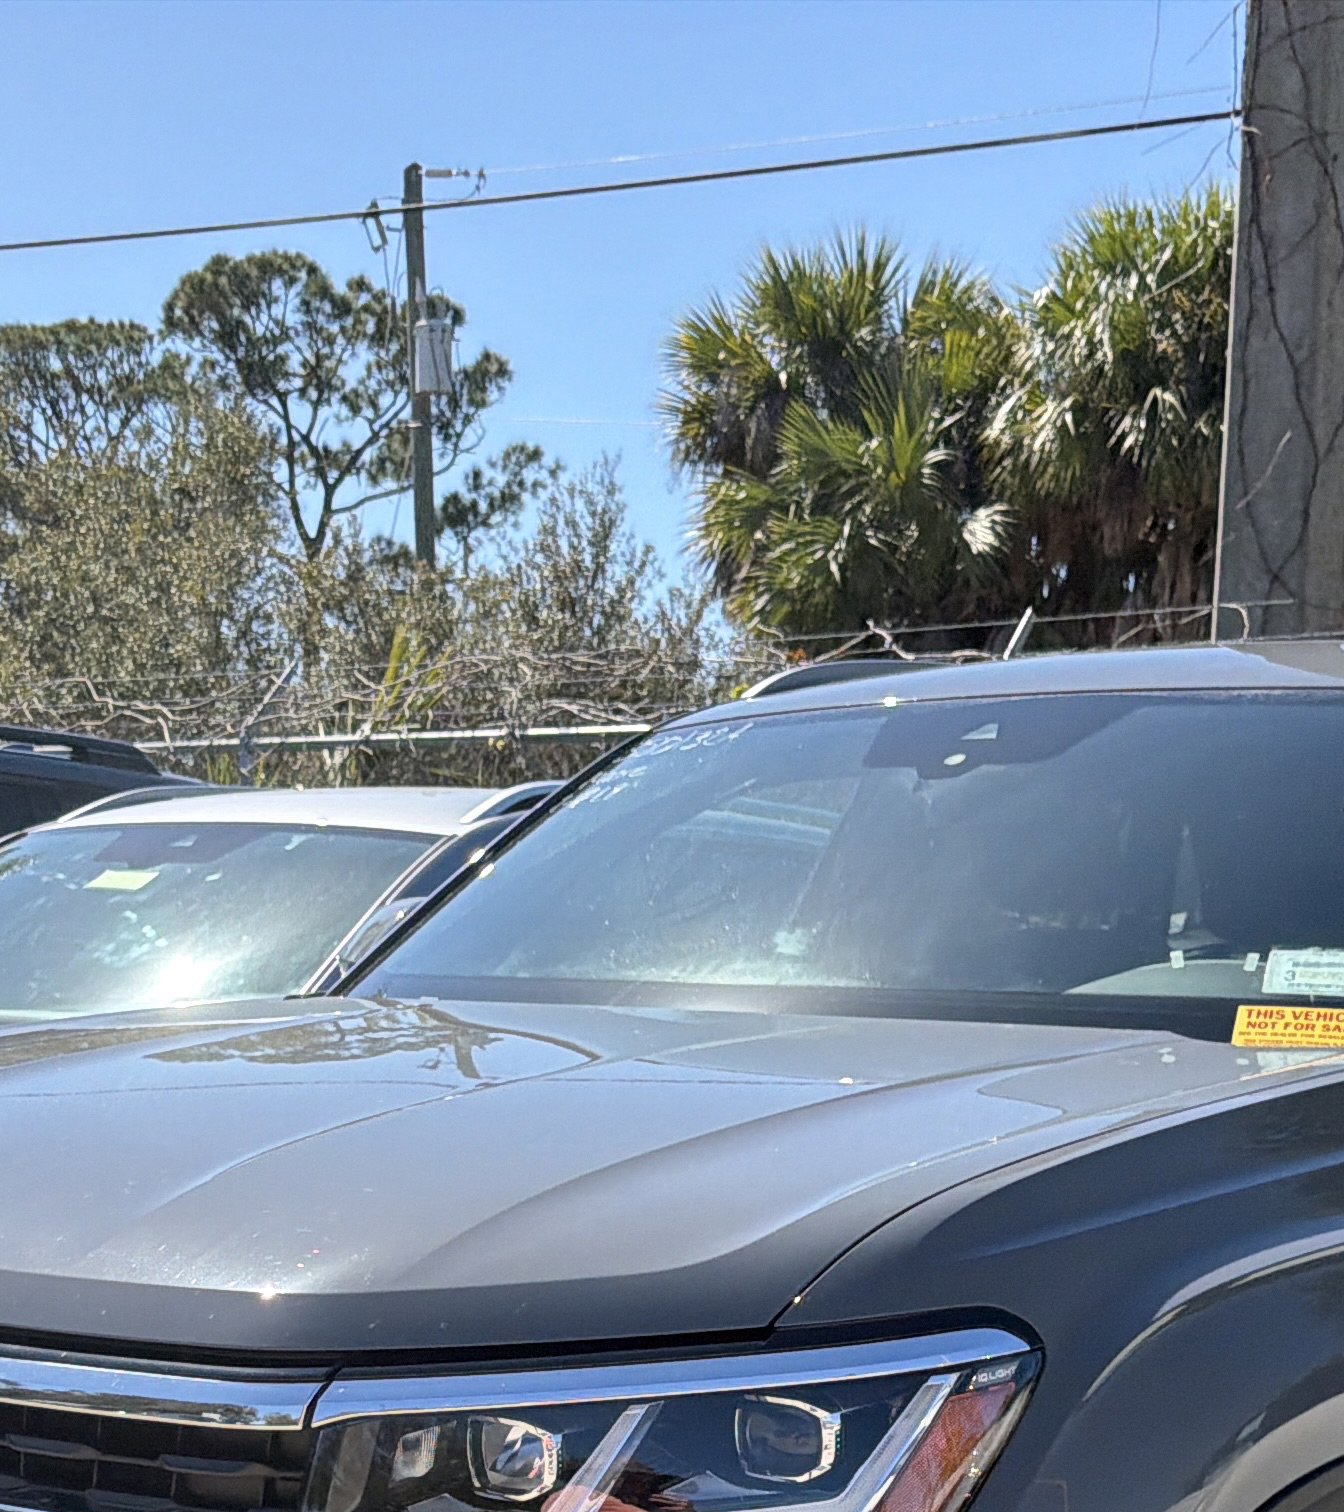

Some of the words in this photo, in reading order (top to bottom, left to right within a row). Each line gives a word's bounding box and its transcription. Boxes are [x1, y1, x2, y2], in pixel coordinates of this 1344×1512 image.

[1284, 969, 1296, 982] 3
[1246, 1008, 1286, 1020] THIS
[1246, 1020, 1278, 1030] NOT
[1283, 1021, 1317, 1032] FOR
